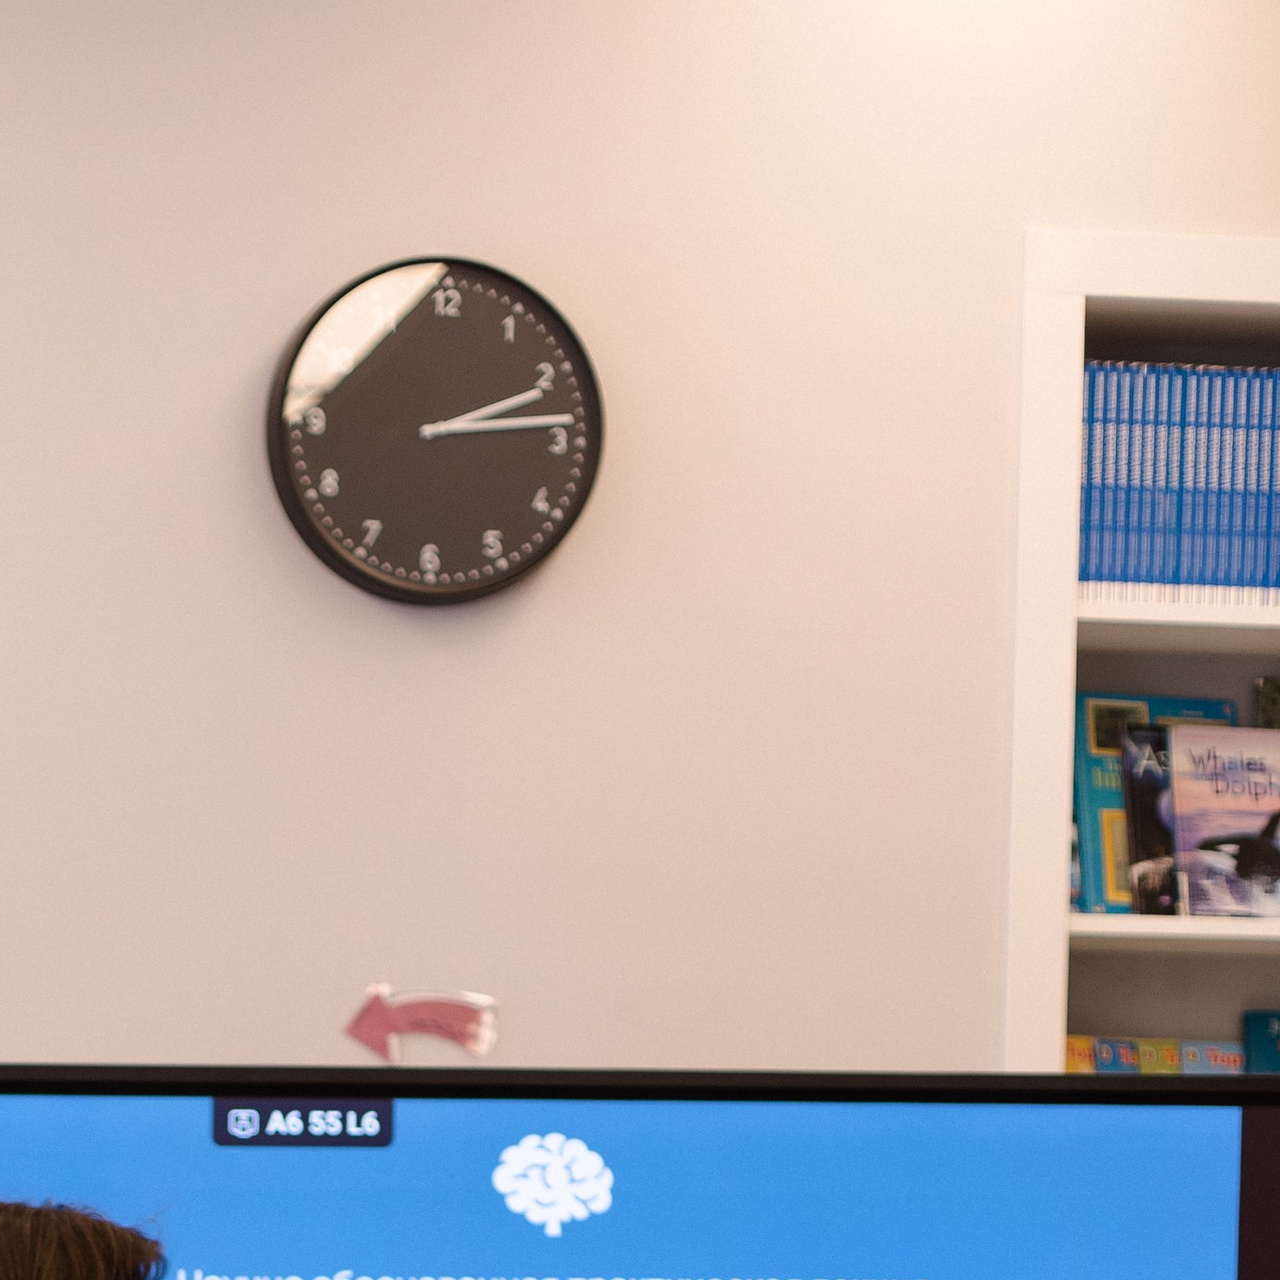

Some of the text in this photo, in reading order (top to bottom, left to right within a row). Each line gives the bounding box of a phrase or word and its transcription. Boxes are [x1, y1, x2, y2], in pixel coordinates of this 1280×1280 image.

[431, 288, 464, 318] 12
[501, 314, 517, 344] 1
[535, 361, 555, 391] 2
[304, 406, 327, 435] 9
[548, 426, 568, 455] 3
[319, 468, 340, 498] 8
[531, 486, 550, 514] 4
[362, 518, 383, 549] 7
[481, 529, 504, 559] 5
[419, 543, 441, 573] 6
[1188, 746, 1268, 774] Whales
[265, 1110, 304, 1136] A6
[346, 1110, 381, 1136] L6
